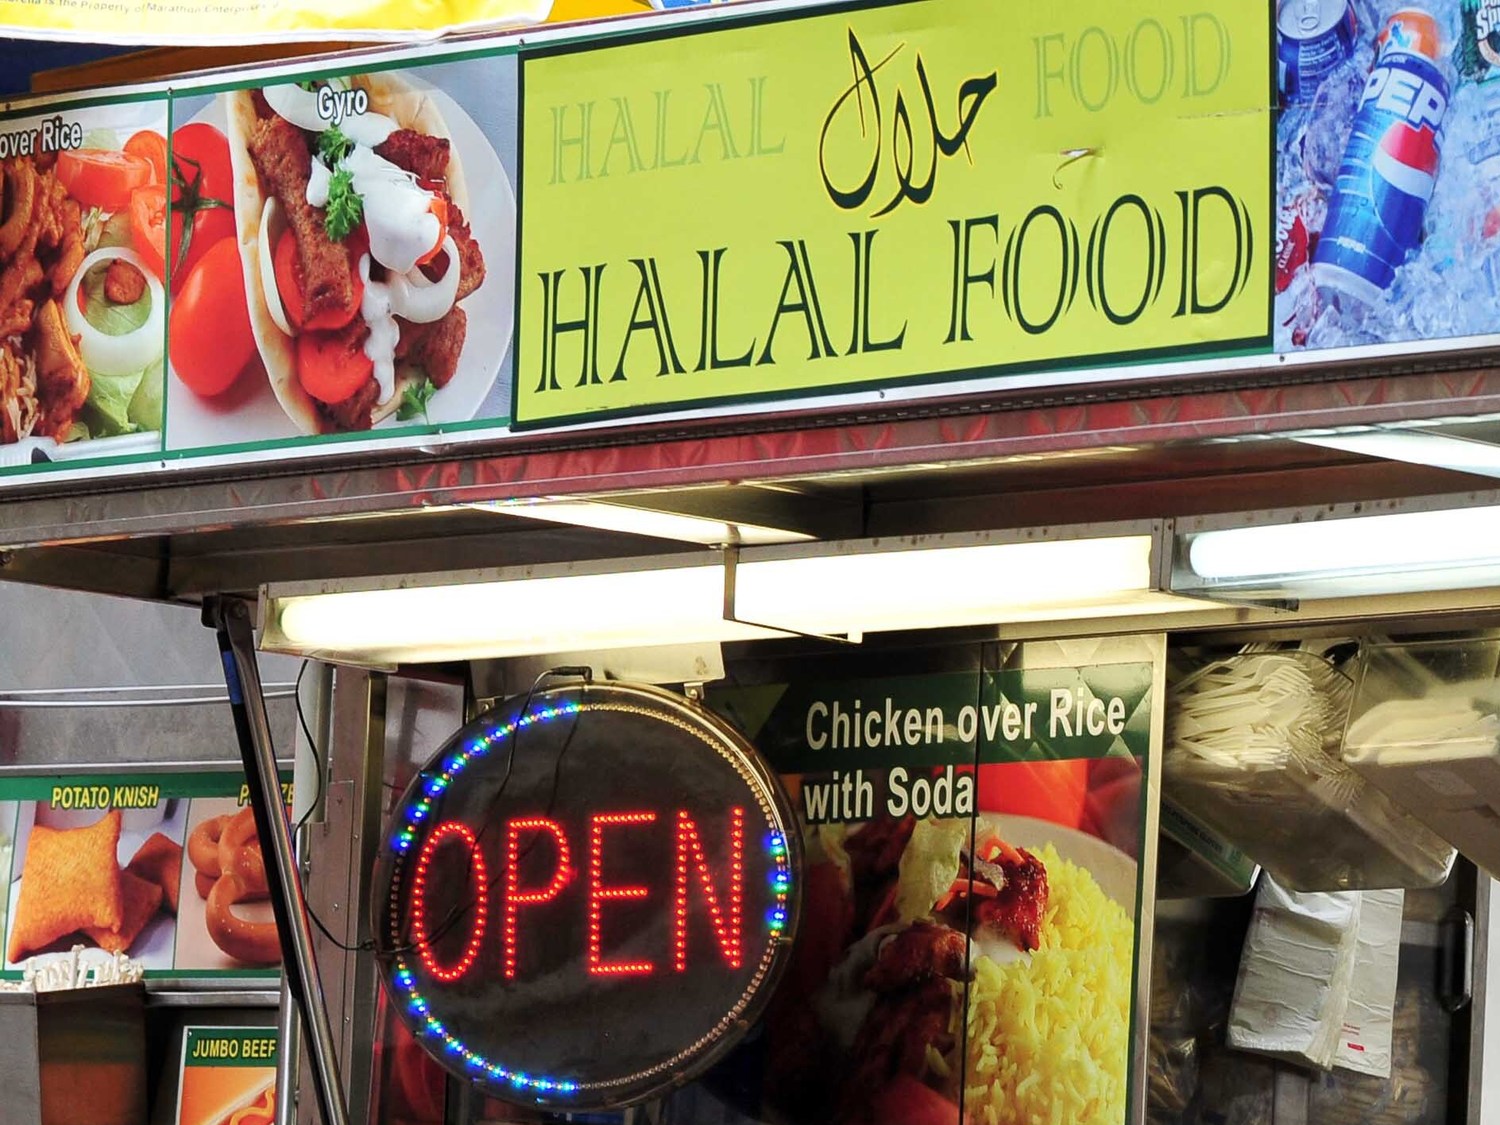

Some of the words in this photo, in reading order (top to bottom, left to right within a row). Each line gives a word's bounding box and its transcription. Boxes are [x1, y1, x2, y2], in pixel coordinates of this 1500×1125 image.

[1033, 12, 1231, 119] FOOD
[317, 84, 369, 120] Gyro
[548, 76, 786, 186] HALAL
[0, 129, 38, 158] over
[41, 120, 83, 152] Rice
[534, 228, 908, 394] HALAL
[942, 186, 1254, 346] FOOD
[804, 697, 947, 752] Chicken
[956, 700, 1037, 744] over
[1048, 688, 1127, 740] Rice
[51, 786, 111, 810] POTATO
[113, 785, 160, 808] KNISH
[803, 772, 875, 823] with
[886, 766, 975, 819] Soda
[411, 804, 745, 982] OPEN
[192, 1038, 239, 1059] JUMBO
[242, 1039, 276, 1057] BEEF
